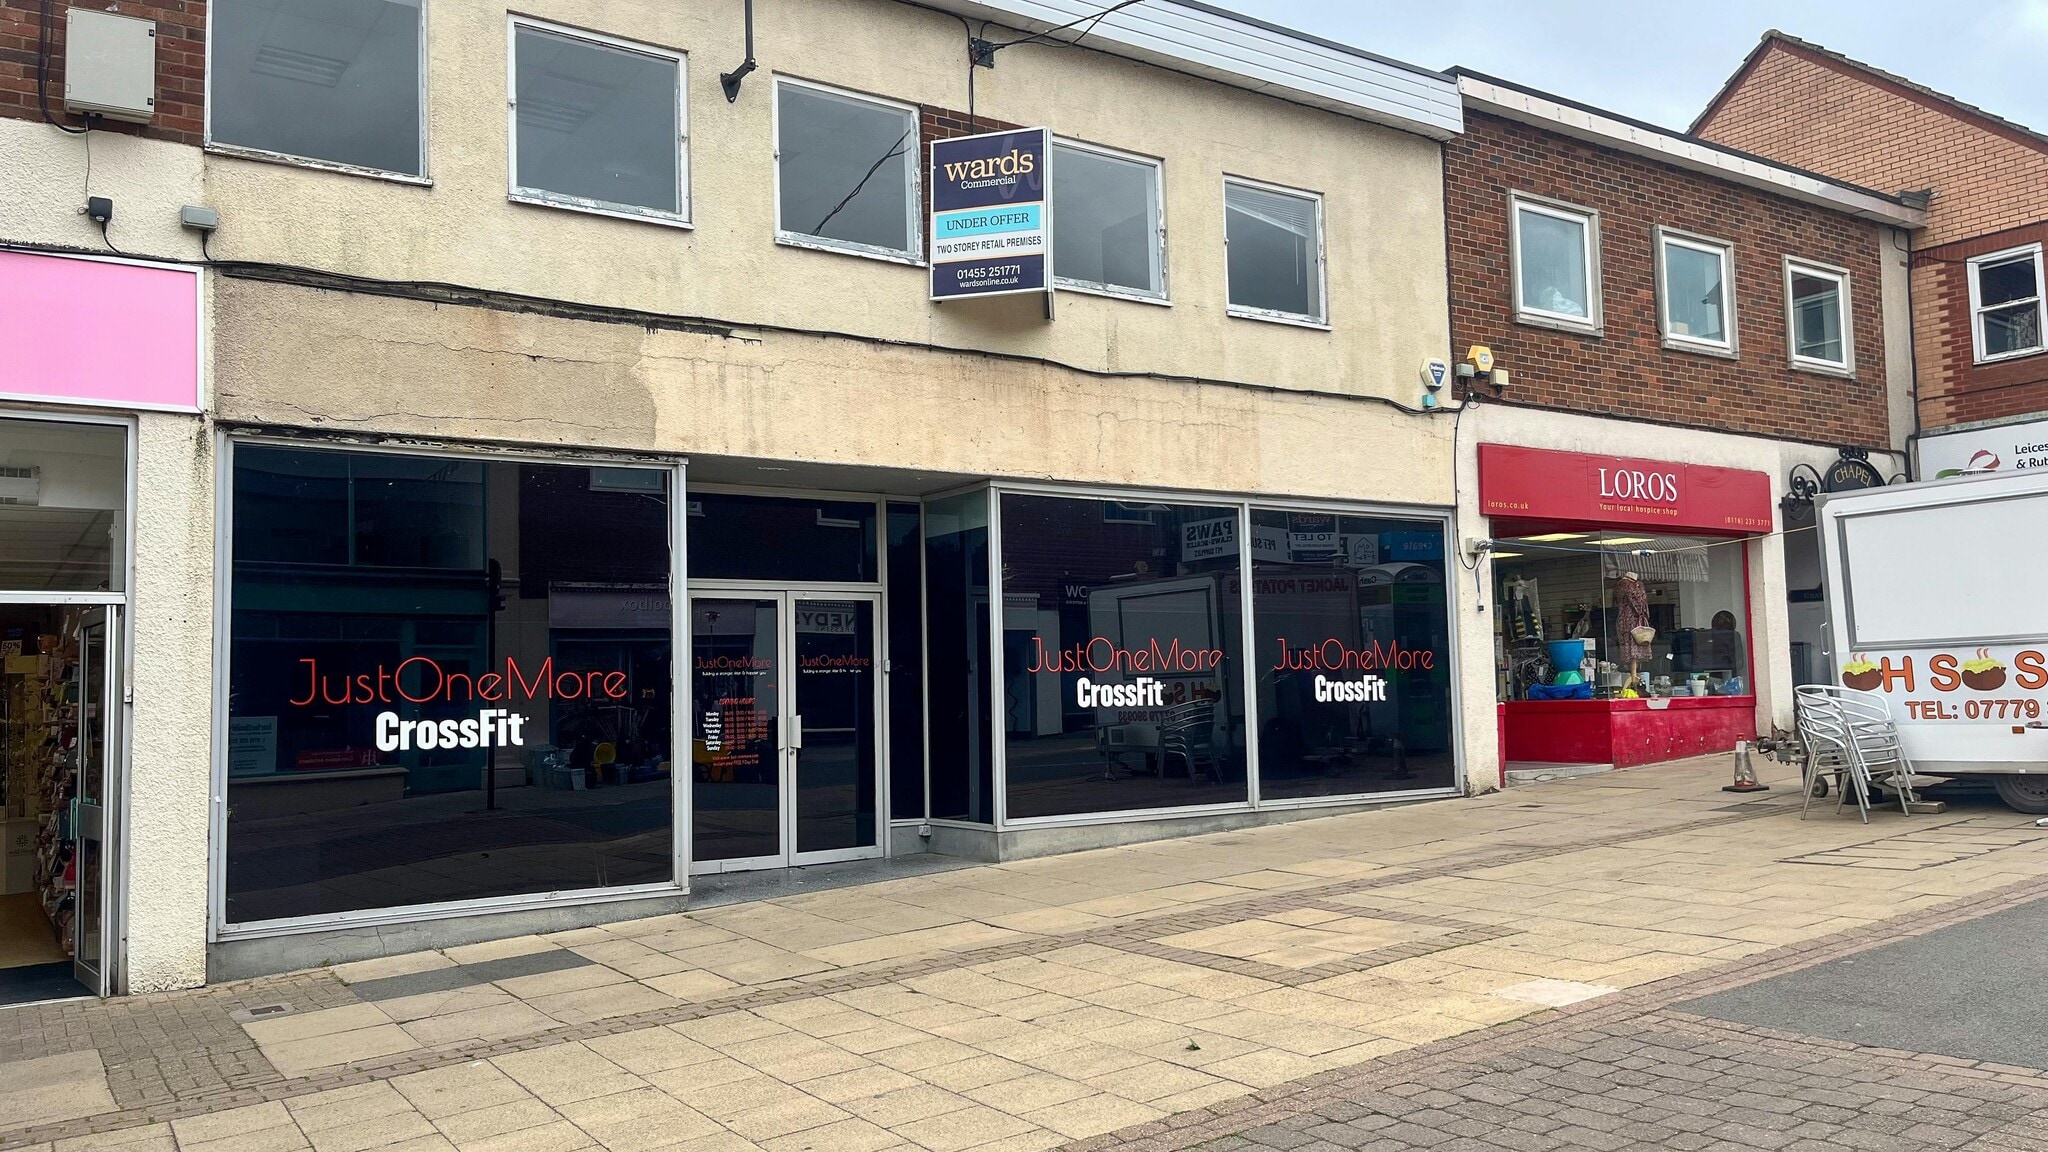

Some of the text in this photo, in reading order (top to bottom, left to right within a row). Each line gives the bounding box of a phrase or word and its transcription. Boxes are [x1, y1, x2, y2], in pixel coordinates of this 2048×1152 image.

[944, 148, 1034, 182] wards
[960, 175, 1017, 190] Commercial
[946, 213, 1030, 231] UNDER OFFER
[937, 235, 1042, 255] TWO STOREY RETAIL PREMISES
[957, 264, 1020, 280] 01455 251771
[959, 276, 1019, 288] wardsonline.co.uk
[2016, 459, 2026, 469] &
[1598, 467, 1677, 502] LOROS
[1487, 500, 1529, 511] loros.co.uk
[1599, 503, 1678, 517] Your local hospice shop
[695, 656, 772, 669] JustOneMore
[800, 655, 870, 667] JustOneMore
[1027, 636, 1223, 674] JustOneMore
[1273, 637, 1434, 670] JustOneMore
[289, 655, 628, 707] JustOneMore
[1314, 674, 1386, 702] CrossFit
[1077, 677, 1164, 708] CrossFit
[1905, 699, 2040, 720] TEL: 07779
[376, 708, 525, 752] CrossFit
